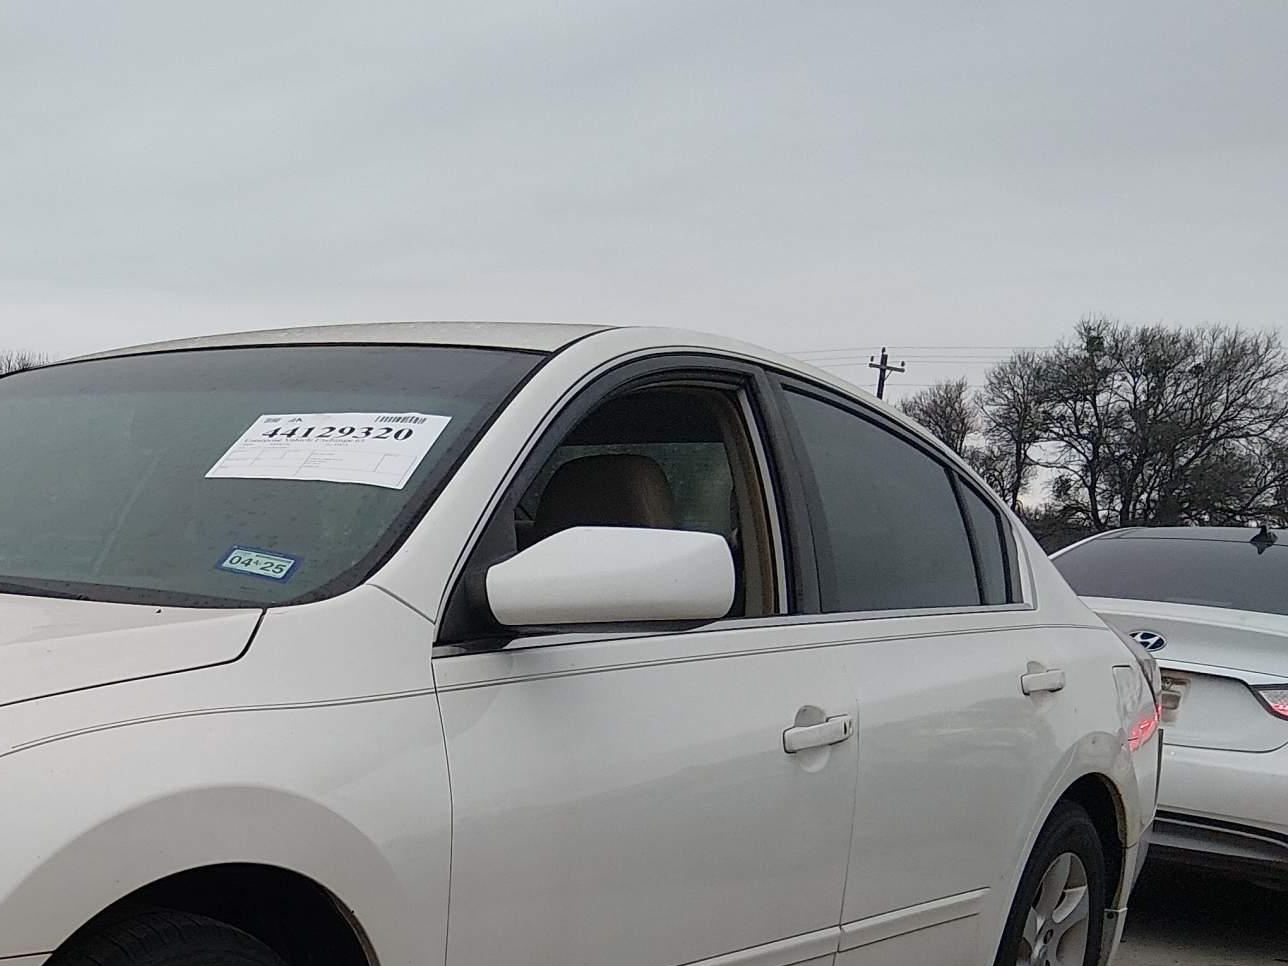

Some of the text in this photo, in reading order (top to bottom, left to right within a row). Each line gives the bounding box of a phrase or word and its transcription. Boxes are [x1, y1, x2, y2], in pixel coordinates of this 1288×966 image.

[261, 426, 414, 441] 44129320
[229, 555, 253, 567] 04
[259, 561, 287, 574] 25
